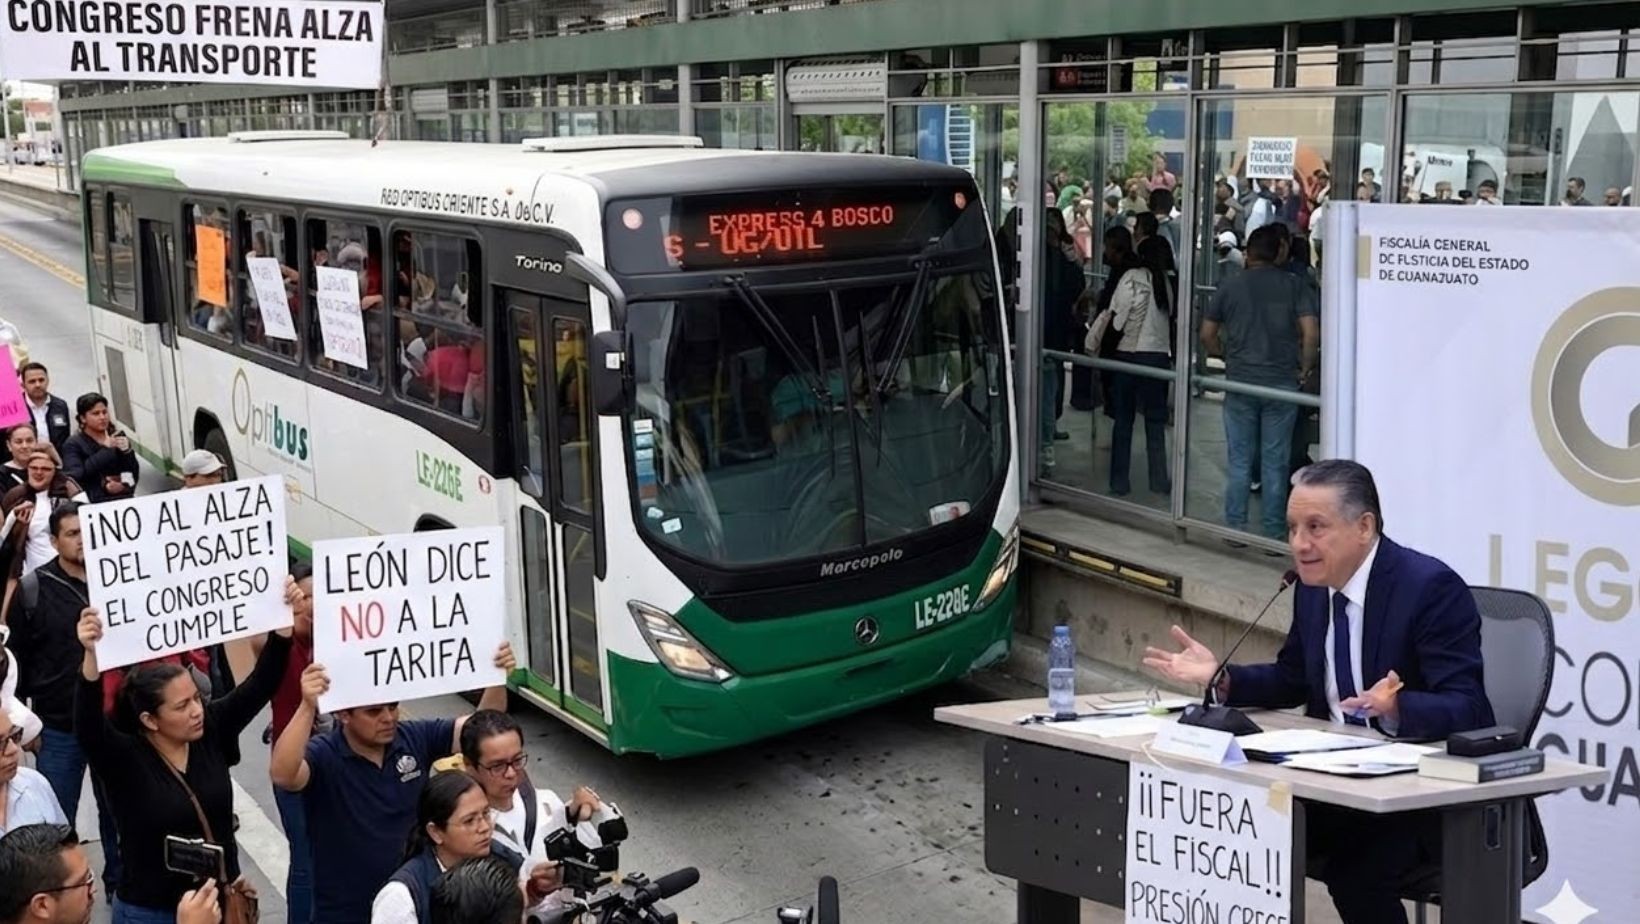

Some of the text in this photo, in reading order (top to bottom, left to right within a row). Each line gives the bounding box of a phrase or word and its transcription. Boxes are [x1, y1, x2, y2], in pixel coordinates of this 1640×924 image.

[8, 0, 374, 42] CONGRESO FRENA ALZA
[71, 41, 317, 78] AL TRANSPORTE
[709, 205, 894, 235] EXPRESS 4 BOSCO
[515, 254, 563, 274] Torino
[1379, 270, 1395, 281] DE
[1452, 256, 1476, 269] DEL
[1479, 257, 1530, 271] ESTADO
[231, 367, 308, 461] Optibus
[88, 483, 272, 550] ¡NO AL ALZA
[99, 520, 274, 588] DEL PASAJE!
[325, 540, 491, 594] LEÓN DICE
[820, 548, 903, 577] Marcopolo
[105, 566, 269, 628] EL CONGRESO
[340, 592, 468, 642] NO A LA
[146, 603, 249, 652] CUMPLE
[364, 637, 476, 687] TARIFA
[1136, 830, 1161, 866] EL
